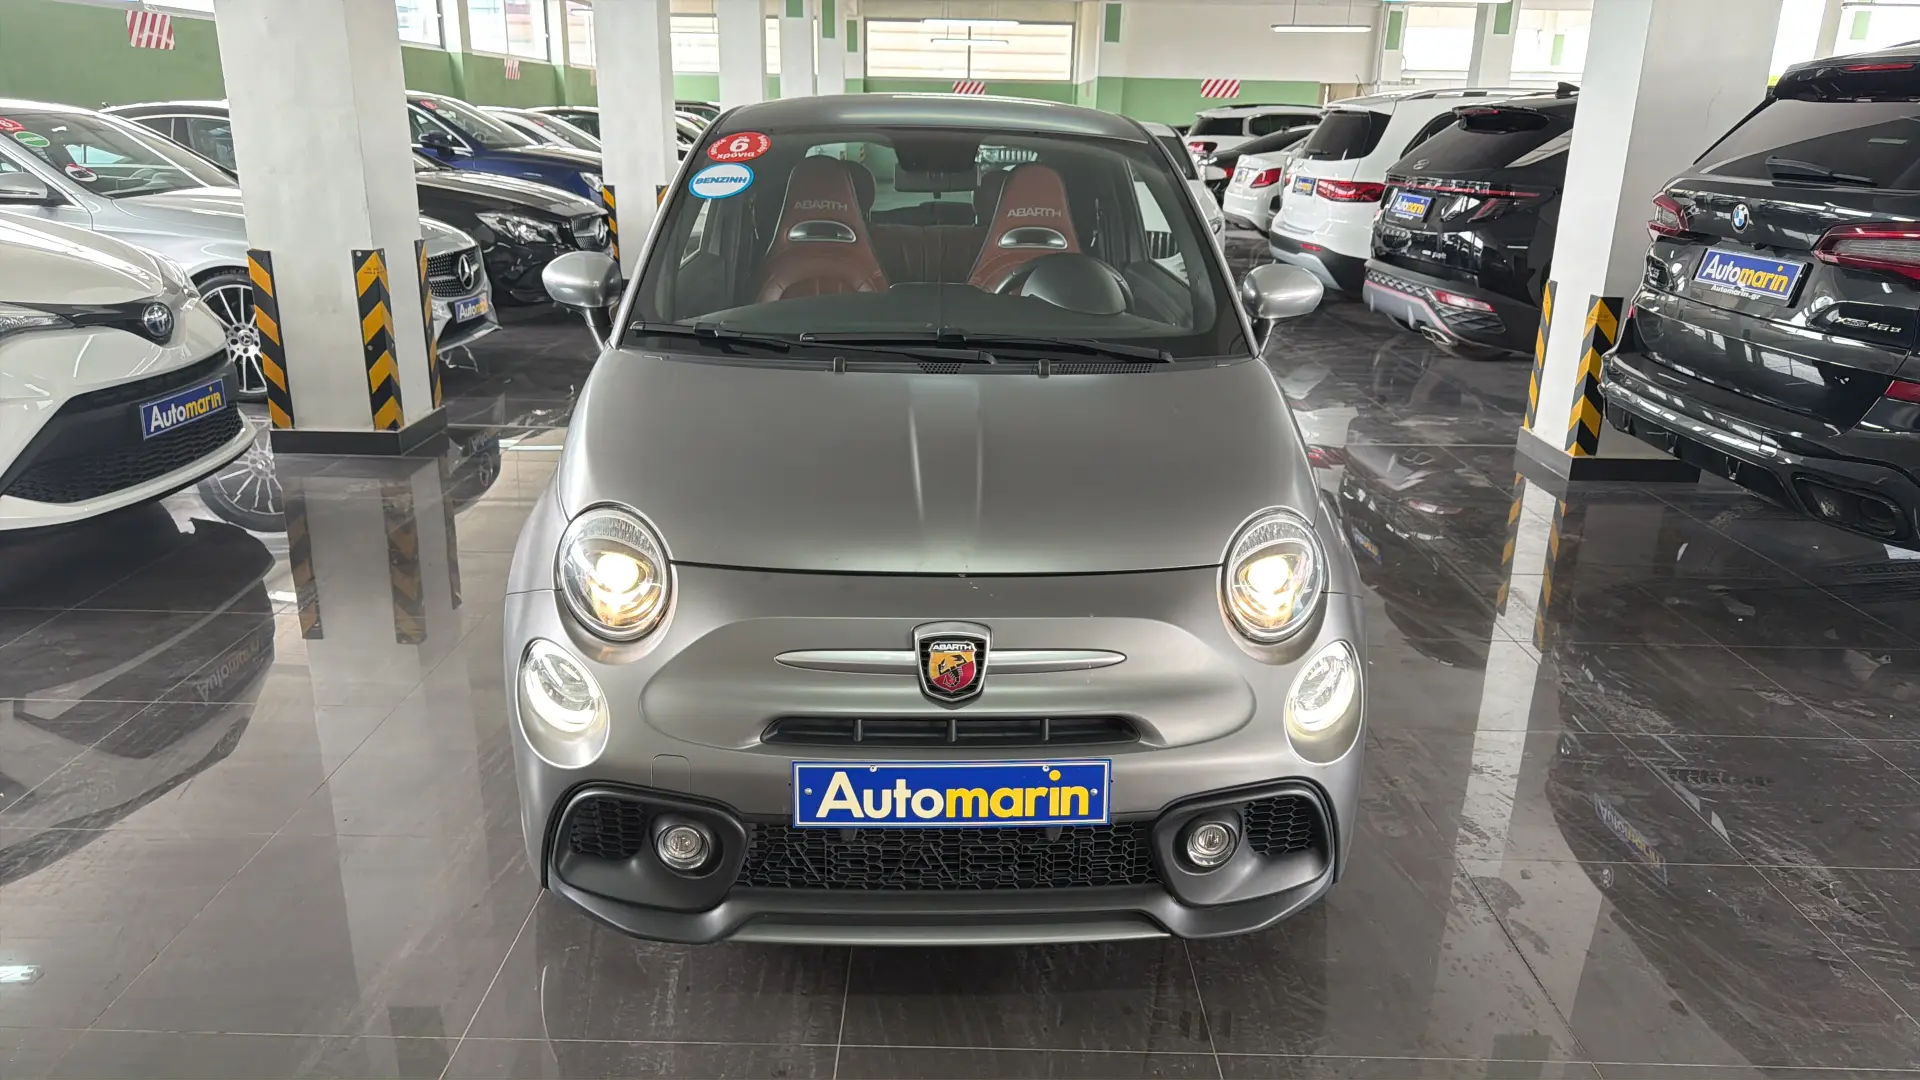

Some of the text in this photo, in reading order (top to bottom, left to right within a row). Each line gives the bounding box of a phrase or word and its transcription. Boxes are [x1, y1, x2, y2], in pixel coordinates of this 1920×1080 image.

[729, 138, 750, 153] 6
[794, 200, 848, 212] ABARTH
[1006, 206, 1062, 218] ABARTH
[1701, 254, 1789, 292] Automarin
[150, 385, 222, 433] Automarin
[932, 643, 972, 651] ABARTH
[815, 770, 1089, 818] Automarin
[755, 841, 1139, 882] ABARTH
